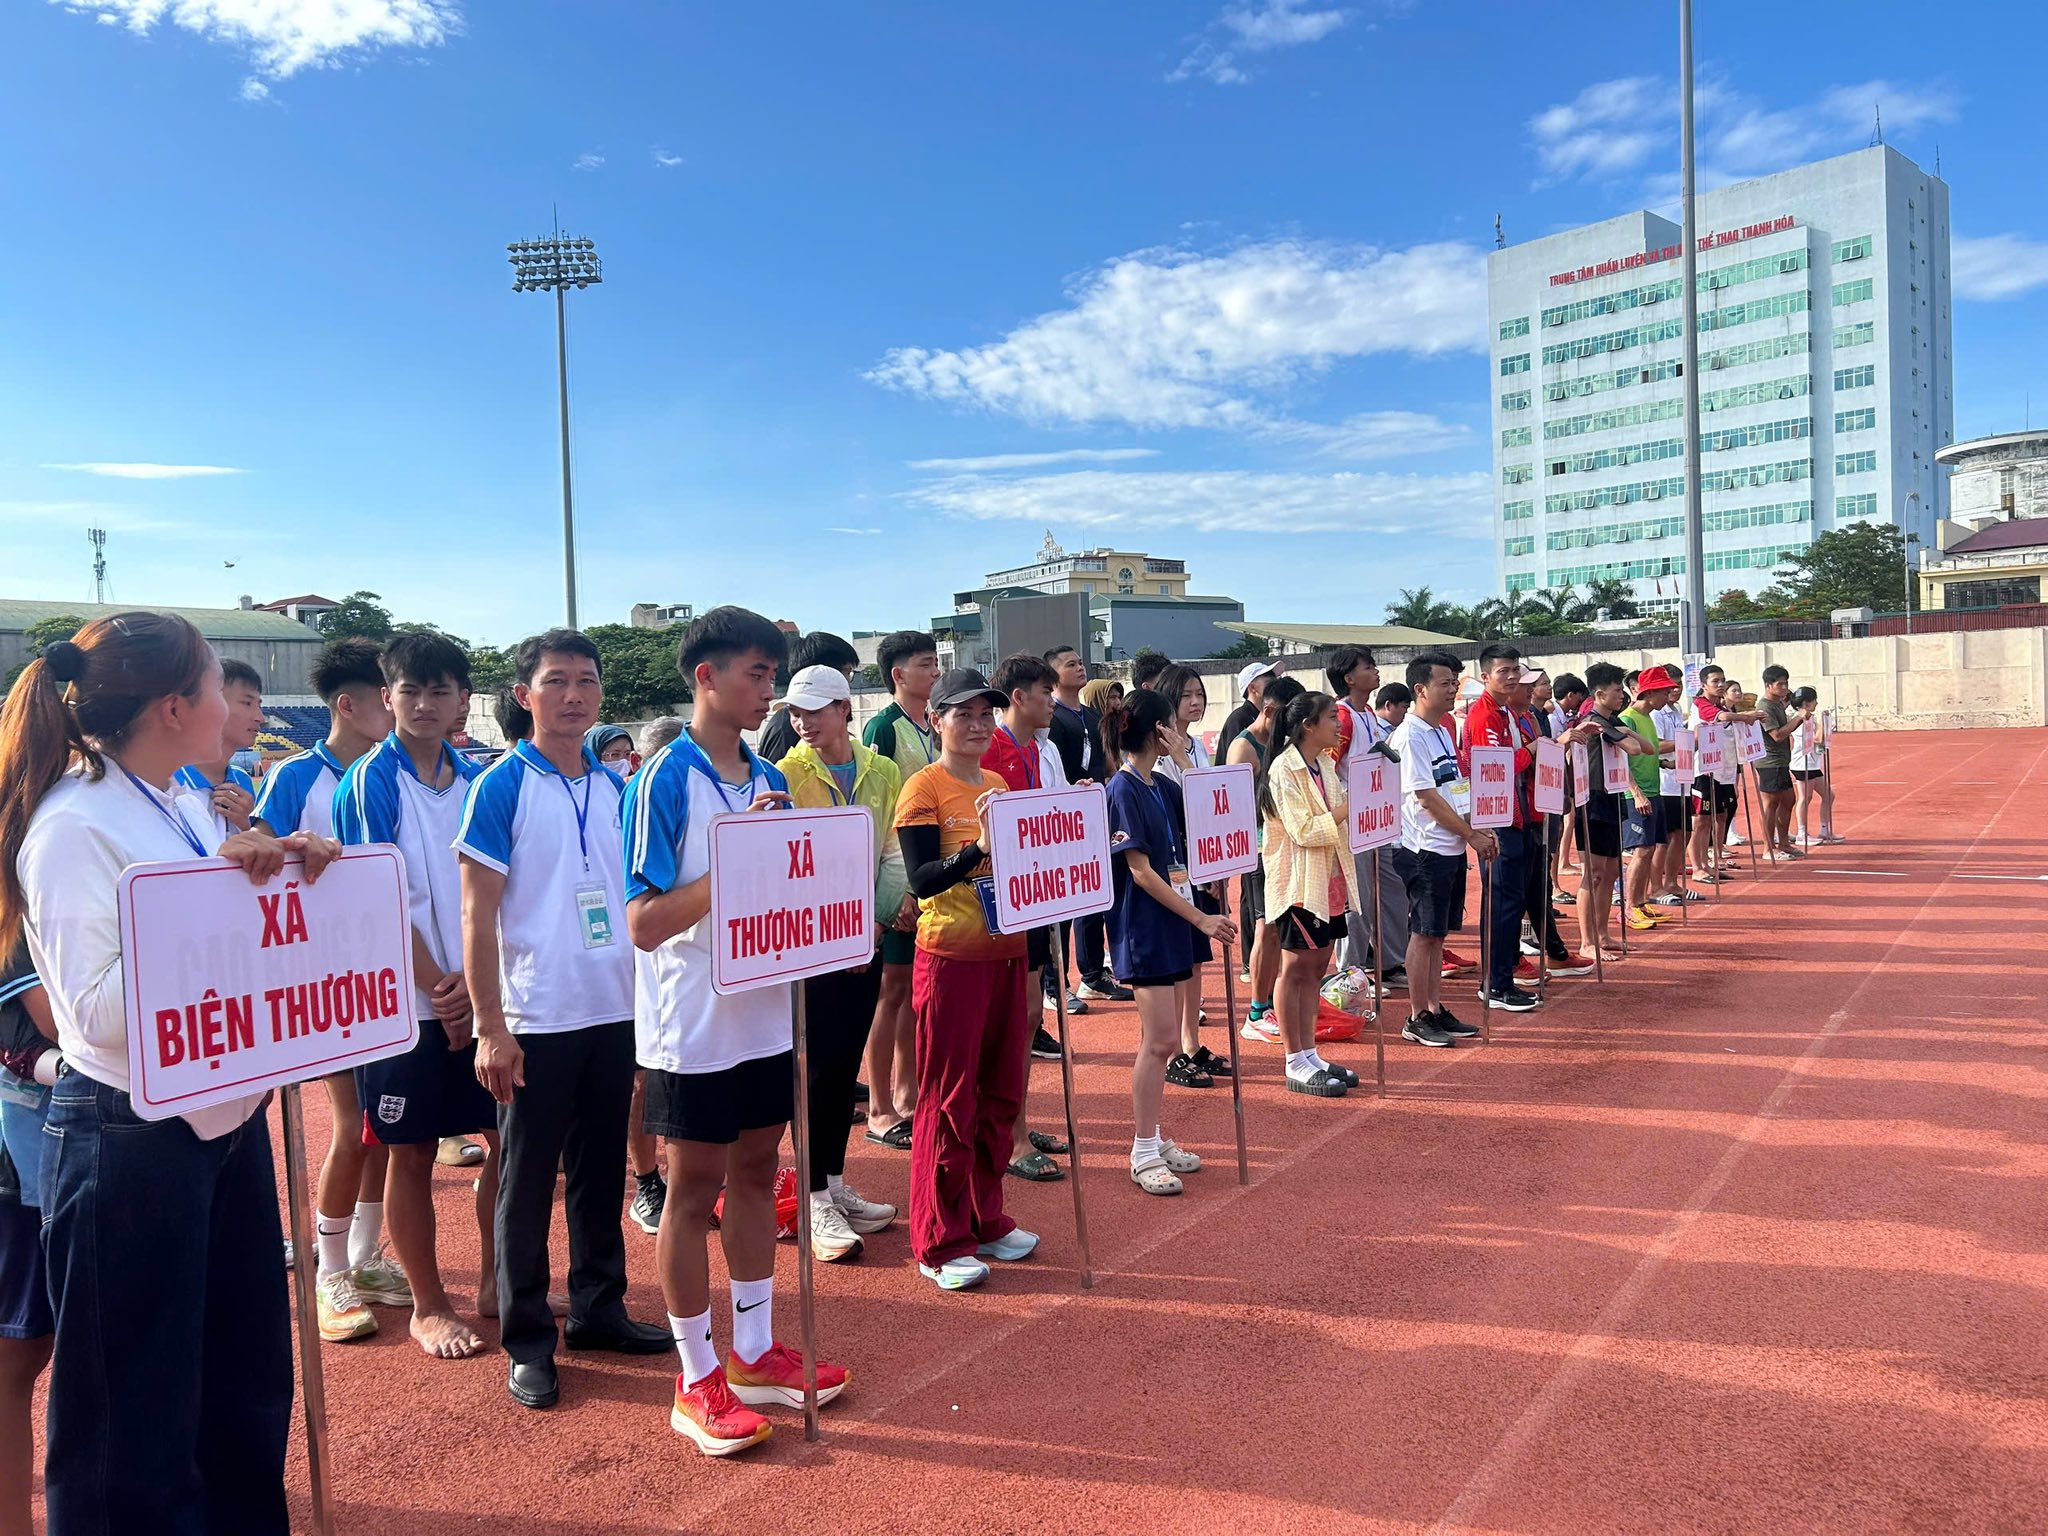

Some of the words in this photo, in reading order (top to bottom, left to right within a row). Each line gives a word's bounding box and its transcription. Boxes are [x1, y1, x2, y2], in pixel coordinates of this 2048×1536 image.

[1550, 271, 1575, 287] TRUNG
[1577, 266, 1594, 280] TÂM
[1662, 245, 1675, 258] THI
[1697, 230, 1714, 250] THỂ
[1716, 229, 1739, 246] THAO
[1742, 220, 1772, 238] THANH
[1775, 214, 1795, 231] HÓA
[1371, 766, 1382, 792] XÃ
[1481, 759, 1505, 782] PHƯỜNG
[1213, 784, 1229, 815] XÃ
[1359, 806, 1376, 837] HẬU
[1380, 801, 1394, 831] LỘC
[1495, 790, 1508, 814] TIẾN
[1017, 806, 1084, 849] PHƯỜNG
[1198, 836, 1223, 865] NGA
[1226, 829, 1249, 859] SƠN
[787, 831, 815, 879] XÃ
[1009, 861, 1066, 911] QUẢNG
[1070, 855, 1101, 895] PHÚ
[257, 880, 309, 948] XÃ
[728, 907, 813, 961] THƯỢNG
[819, 899, 863, 943] NINH
[155, 988, 255, 1070] BIỆN
[264, 967, 399, 1042] THƯỢNG
